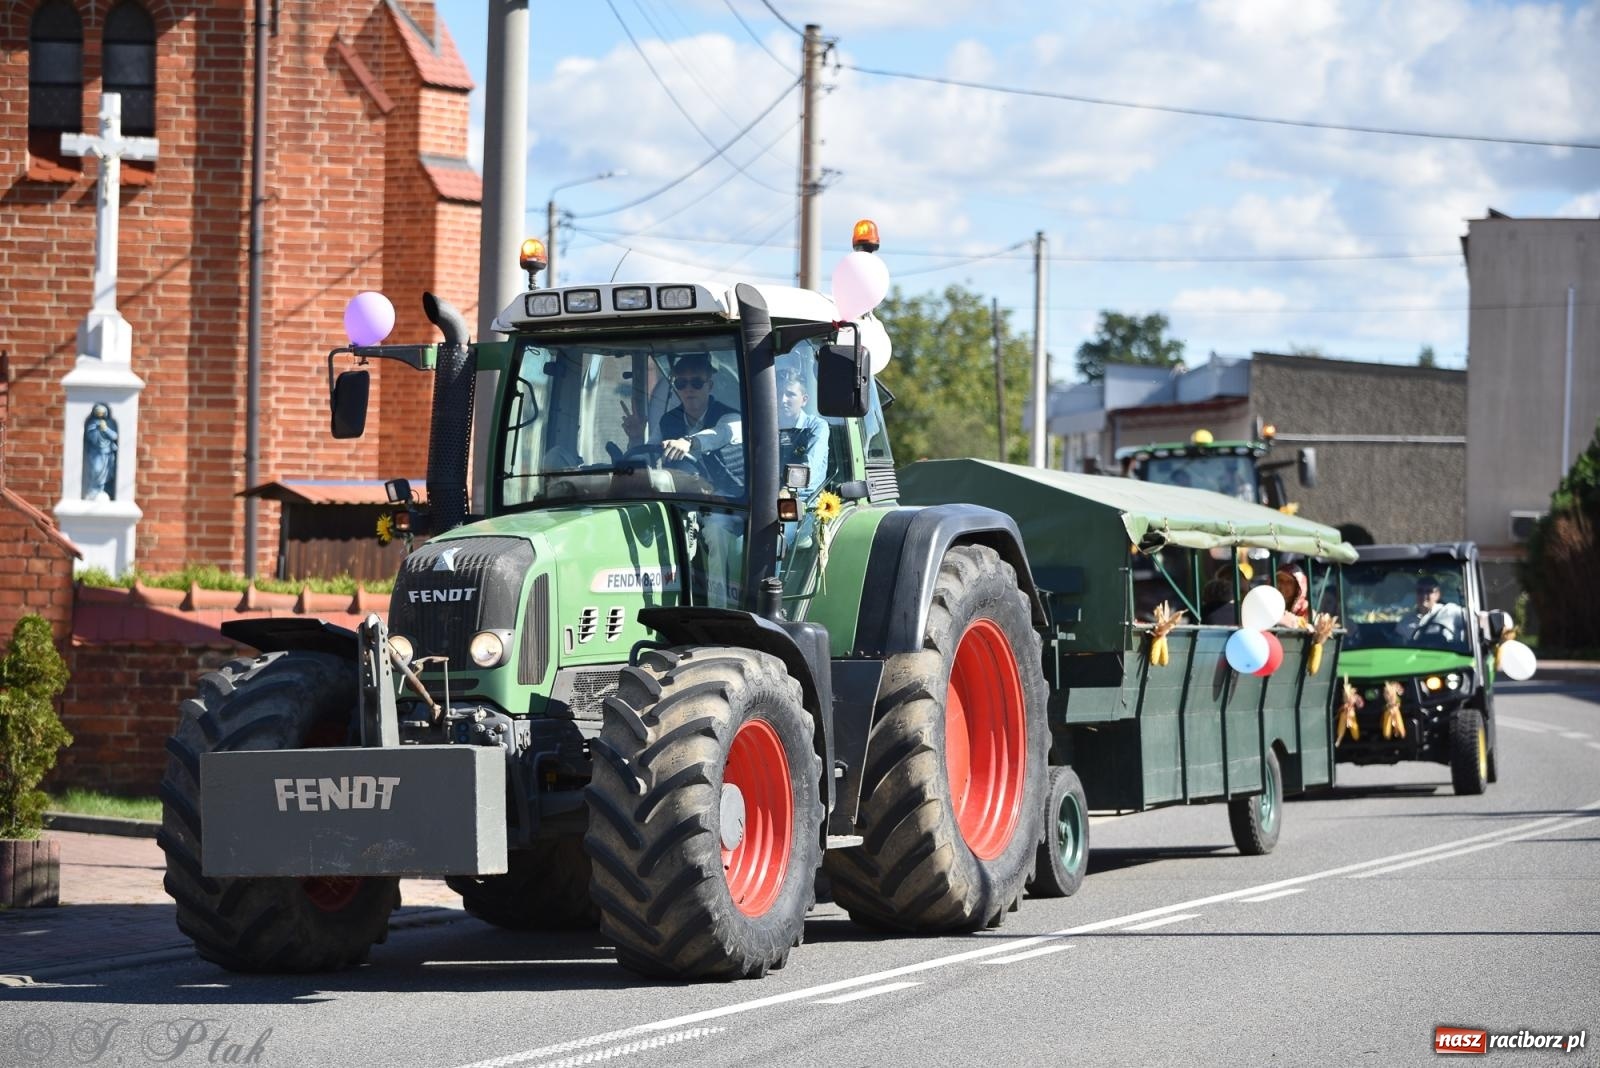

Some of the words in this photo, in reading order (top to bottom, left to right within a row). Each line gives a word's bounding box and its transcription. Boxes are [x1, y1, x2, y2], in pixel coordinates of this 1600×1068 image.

[607, 573, 641, 588] FENDT
[408, 587, 477, 604] FENDT
[274, 776, 401, 812] FENDT
